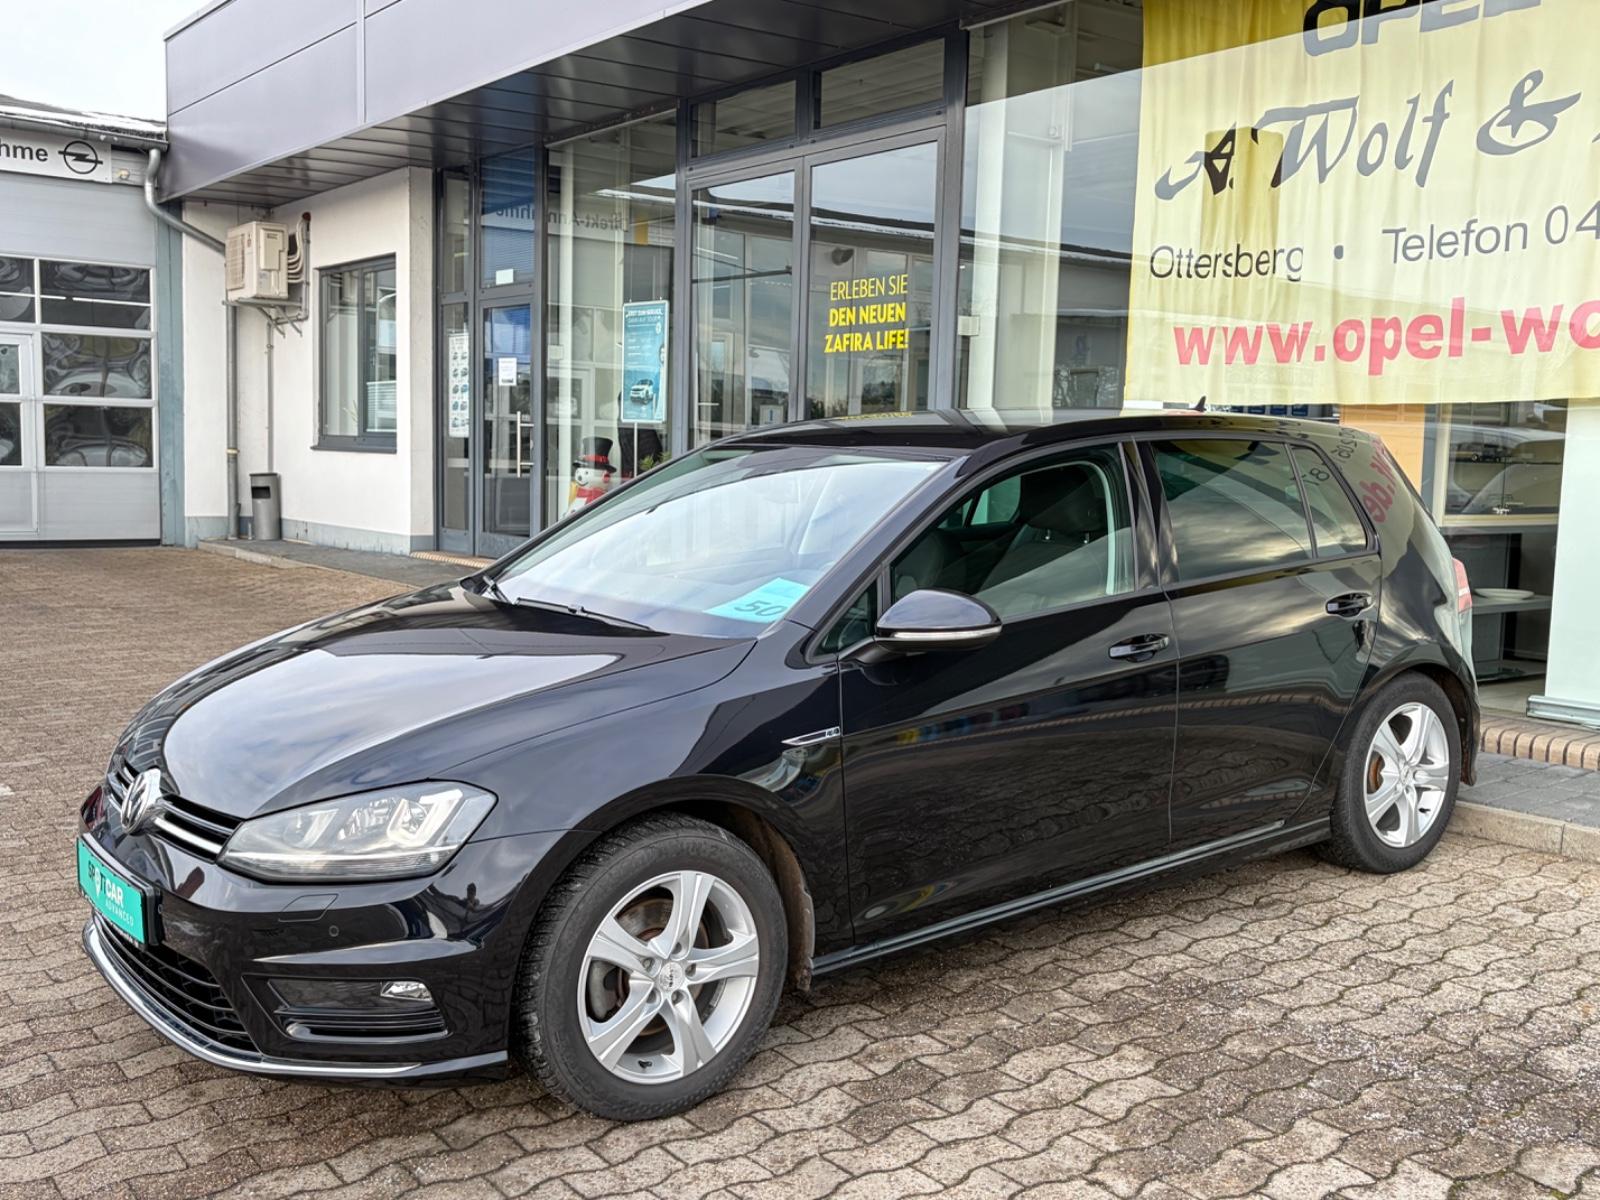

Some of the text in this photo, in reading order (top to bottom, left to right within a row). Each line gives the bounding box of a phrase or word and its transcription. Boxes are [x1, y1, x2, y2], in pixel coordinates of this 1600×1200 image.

[1250, 79, 1454, 188] Wolf
[1476, 69, 1581, 156] &
[1150, 243, 1304, 282] Ottersberg
[1382, 219, 1528, 264] Telefon
[830, 274, 908, 301] ERLEBEN SIE
[829, 302, 906, 327] DEN NEUEN
[824, 328, 909, 353] ZAFIRA LIFE!
